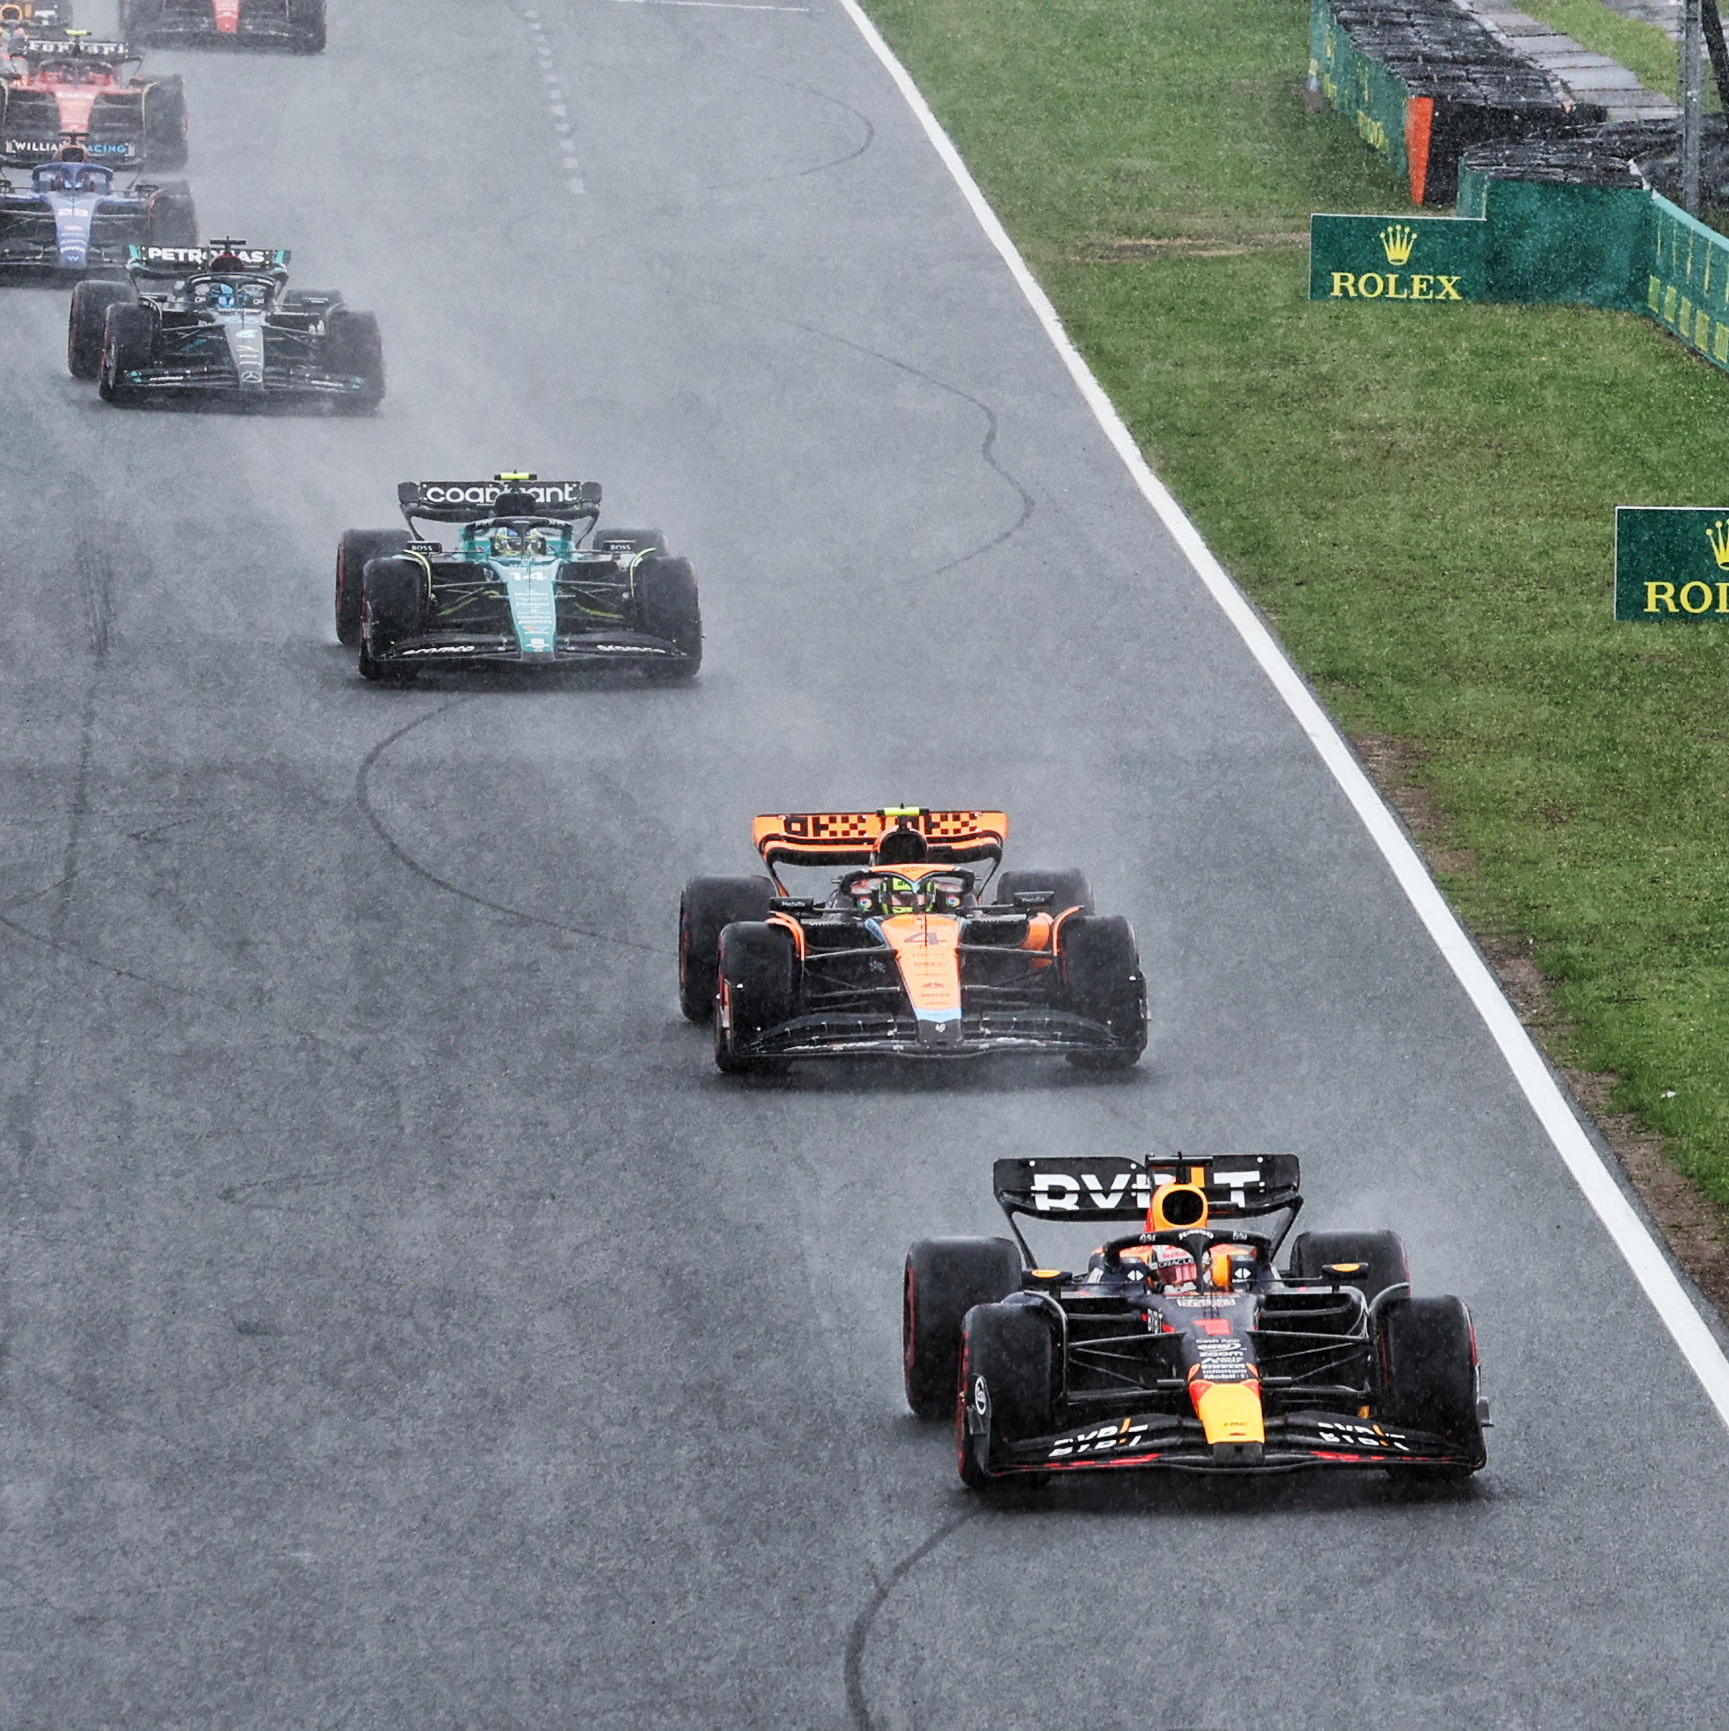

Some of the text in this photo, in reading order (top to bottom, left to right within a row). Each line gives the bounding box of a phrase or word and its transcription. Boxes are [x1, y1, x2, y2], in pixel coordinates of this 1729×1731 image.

[1331, 271, 1463, 302] ROLEX
[411, 544, 433, 552] BOSS
[610, 544, 631, 552] BOSS
[509, 572, 546, 583] 14
[903, 931, 946, 946] 4
